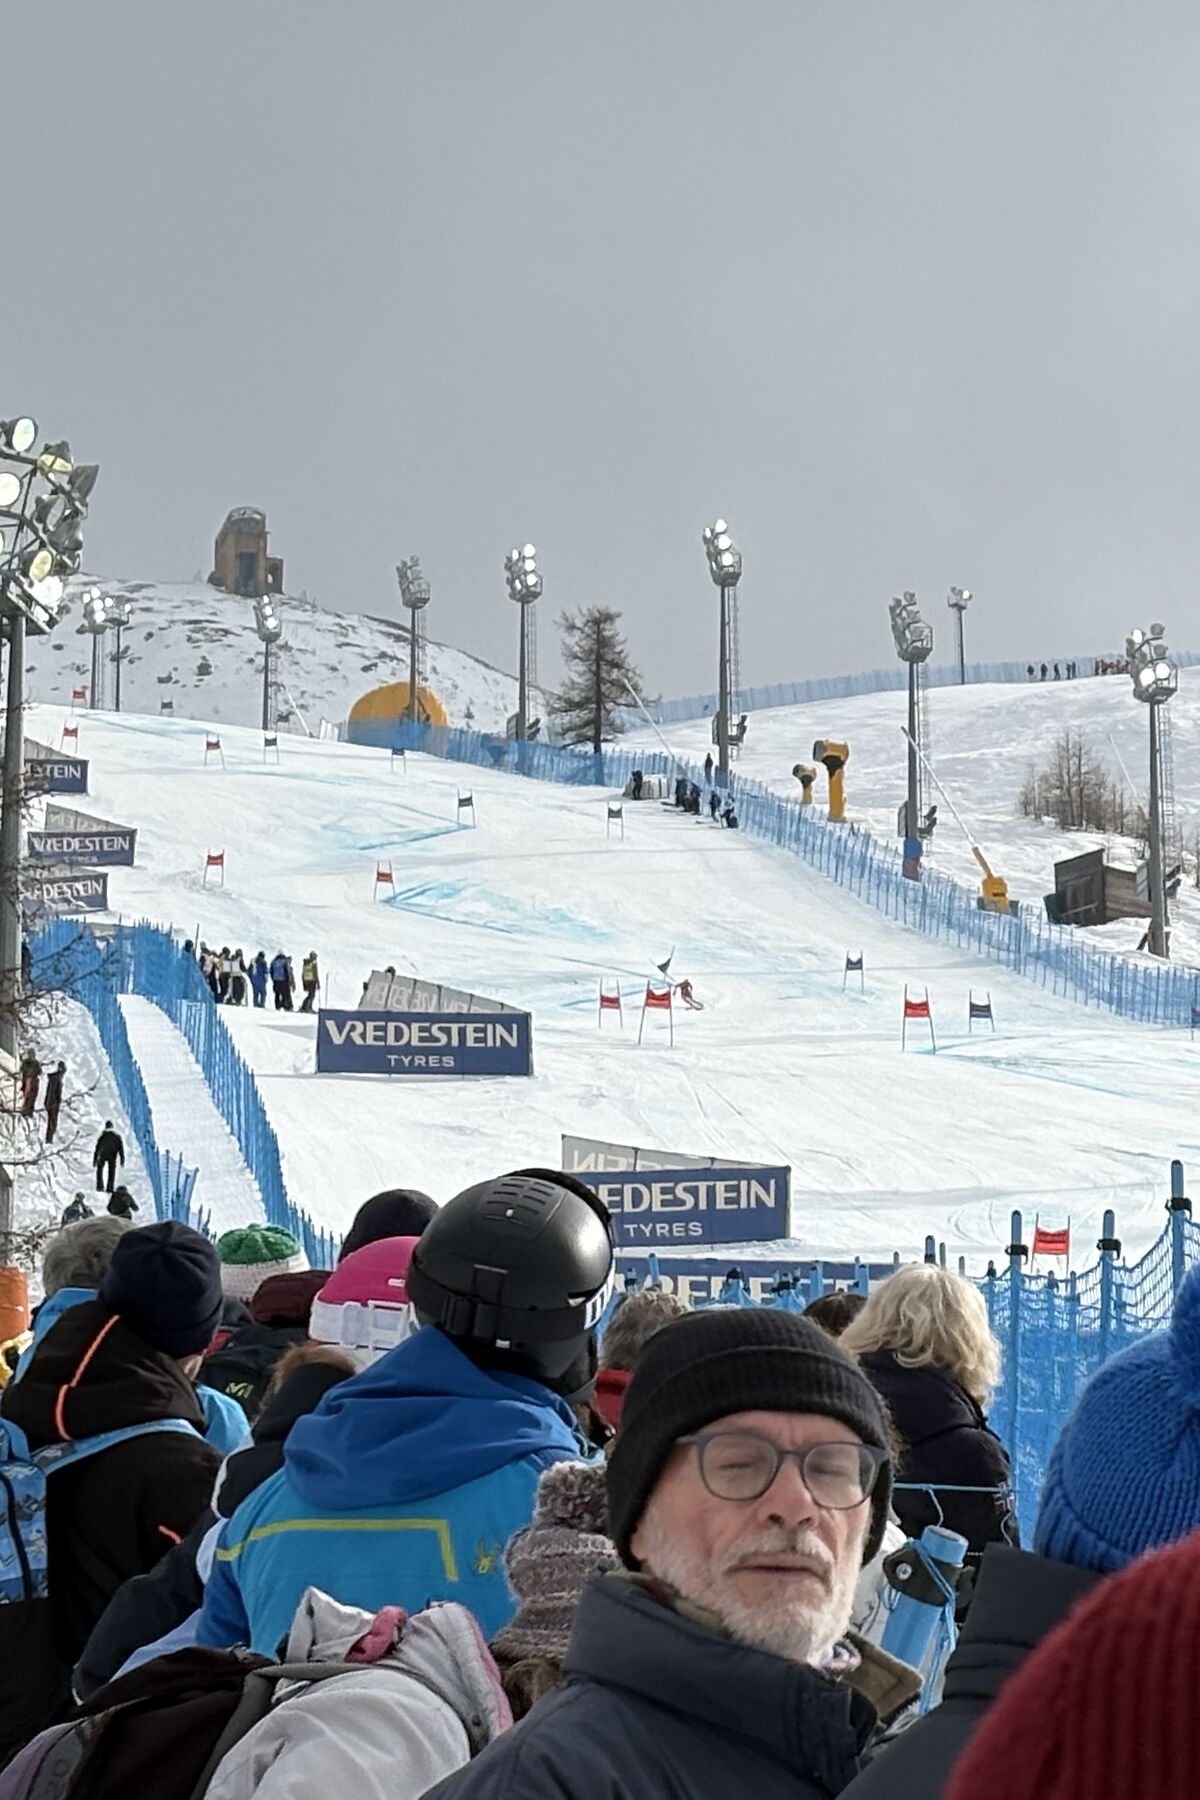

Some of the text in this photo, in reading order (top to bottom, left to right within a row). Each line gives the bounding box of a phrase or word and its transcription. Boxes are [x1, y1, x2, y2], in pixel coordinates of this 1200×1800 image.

[20, 878, 104, 901] DESTEIN
[324, 1019, 518, 1048] VREDESTEIN
[386, 1054, 455, 1068] TYRES
[623, 1221, 703, 1238] TYRES
